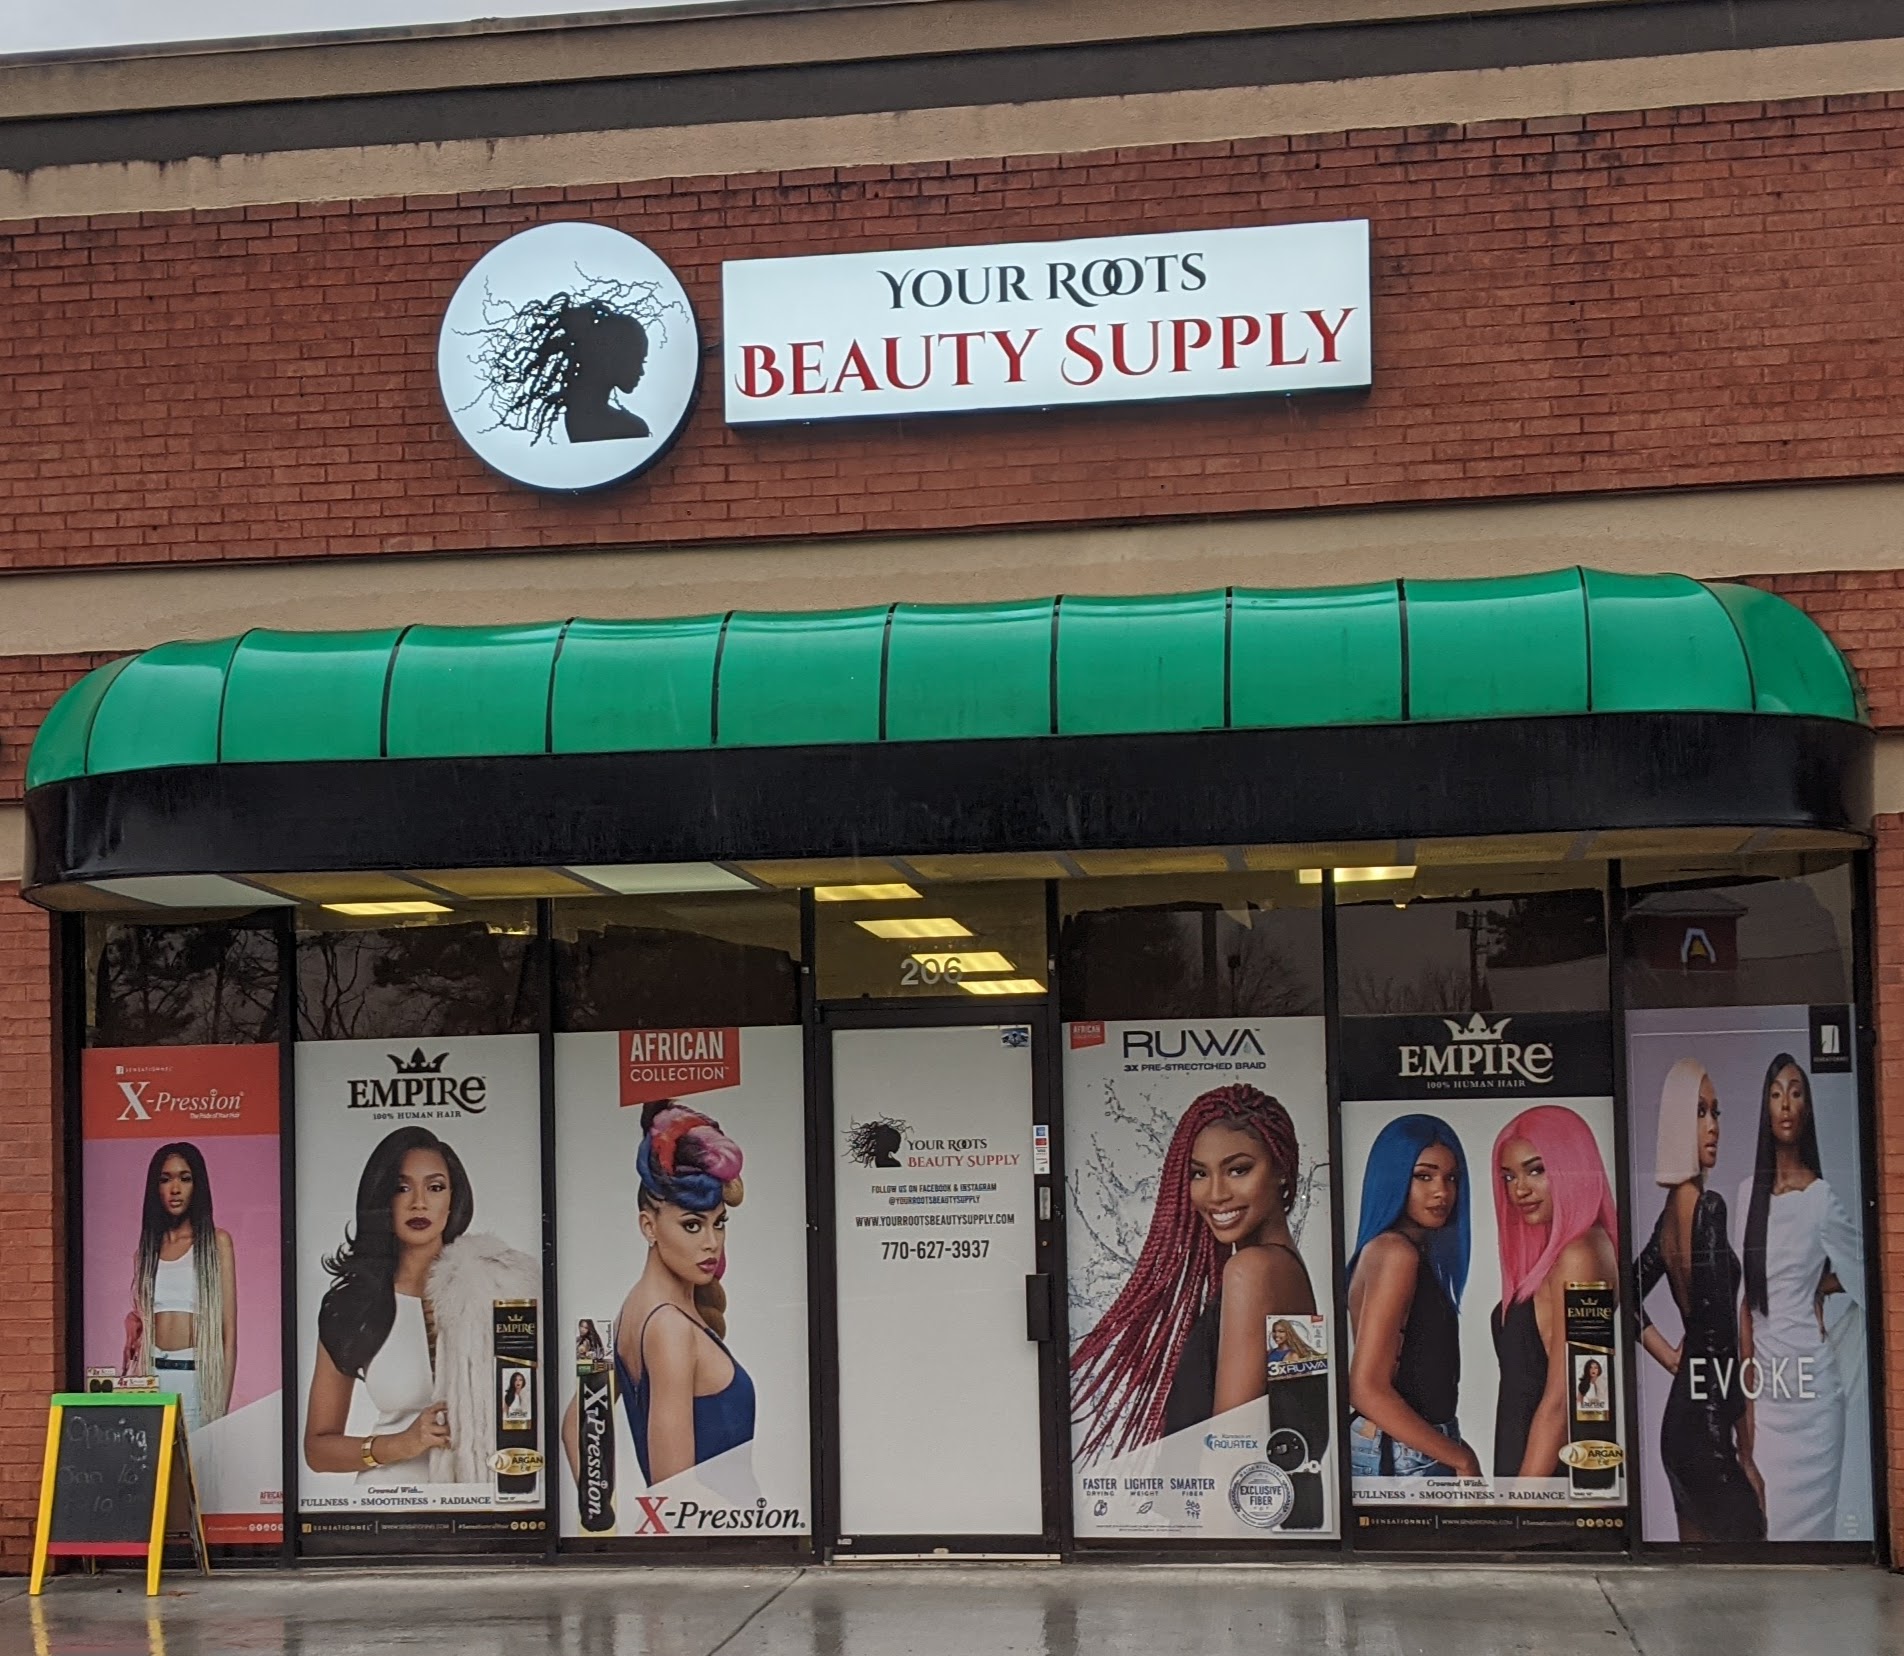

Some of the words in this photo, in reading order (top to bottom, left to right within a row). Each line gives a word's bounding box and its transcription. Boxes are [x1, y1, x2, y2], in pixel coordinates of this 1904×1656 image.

[876, 264, 1033, 309] YOUR
[1046, 252, 1207, 307] ROOTS
[734, 328, 1043, 398] BEAUTY
[1060, 307, 1357, 386] SUPPLY
[901, 957, 963, 985] 206
[630, 1031, 724, 1062] AFRICAN
[1123, 1028, 1266, 1058] RUWA
[1235, 1061, 1267, 1070] BRAID
[630, 1066, 725, 1082] COLLECTION
[1427, 1081, 1450, 1089] 100%
[1454, 1080, 1494, 1088] HUMAN
[1498, 1079, 1526, 1087] HAIR
[116, 1081, 241, 1121] X-Pression
[373, 1112, 394, 1120] 100%
[397, 1111, 433, 1119] HUMAN
[436, 1110, 462, 1118] HAIR
[907, 1139, 944, 1151] YOUR
[948, 1138, 988, 1152] ROOTS
[907, 1155, 963, 1168] BEAUTY
[967, 1154, 1021, 1168] SUPPLY
[871, 1185, 897, 1194] FOLLOW
[899, 1185, 907, 1193] US
[909, 1184, 918, 1193] ON
[919, 1184, 951, 1192] FACEBOOK
[953, 1183, 958, 1192] &
[960, 1182, 997, 1192] INSTAGRAM
[889, 1195, 981, 1205] @YOURROOTSBEAUTYSUPPLY
[855, 1214, 1015, 1227] WWW.YOURROOTSBEAUTYSUPPLY.COM
[881, 1240, 990, 1260] 770-627-3937
[1287, 1360, 1328, 1373] RUWA
[1689, 1356, 1816, 1400] EVOKE
[584, 1383, 609, 1516] X-Pression
[1213, 1440, 1258, 1449] AQUATEX
[1587, 1449, 1624, 1458] ARGAN
[512, 1456, 544, 1465] ARGAN
[1083, 1478, 1117, 1490] FASTER
[1124, 1478, 1164, 1490] LIGHTER
[1170, 1478, 1215, 1490] SMARTER
[1239, 1485, 1282, 1496] EXCLUSIVE
[1352, 1490, 1406, 1499] FULLNESS
[1419, 1490, 1495, 1500] SMOOTHNESS
[1508, 1490, 1565, 1500] RADIANCE
[300, 1498, 349, 1507] FULLNESS
[361, 1497, 429, 1506] SMOOTHNESS
[440, 1496, 491, 1505] RADIANCE
[1249, 1495, 1273, 1506] FIBER
[635, 1497, 802, 1534] X-Pression
